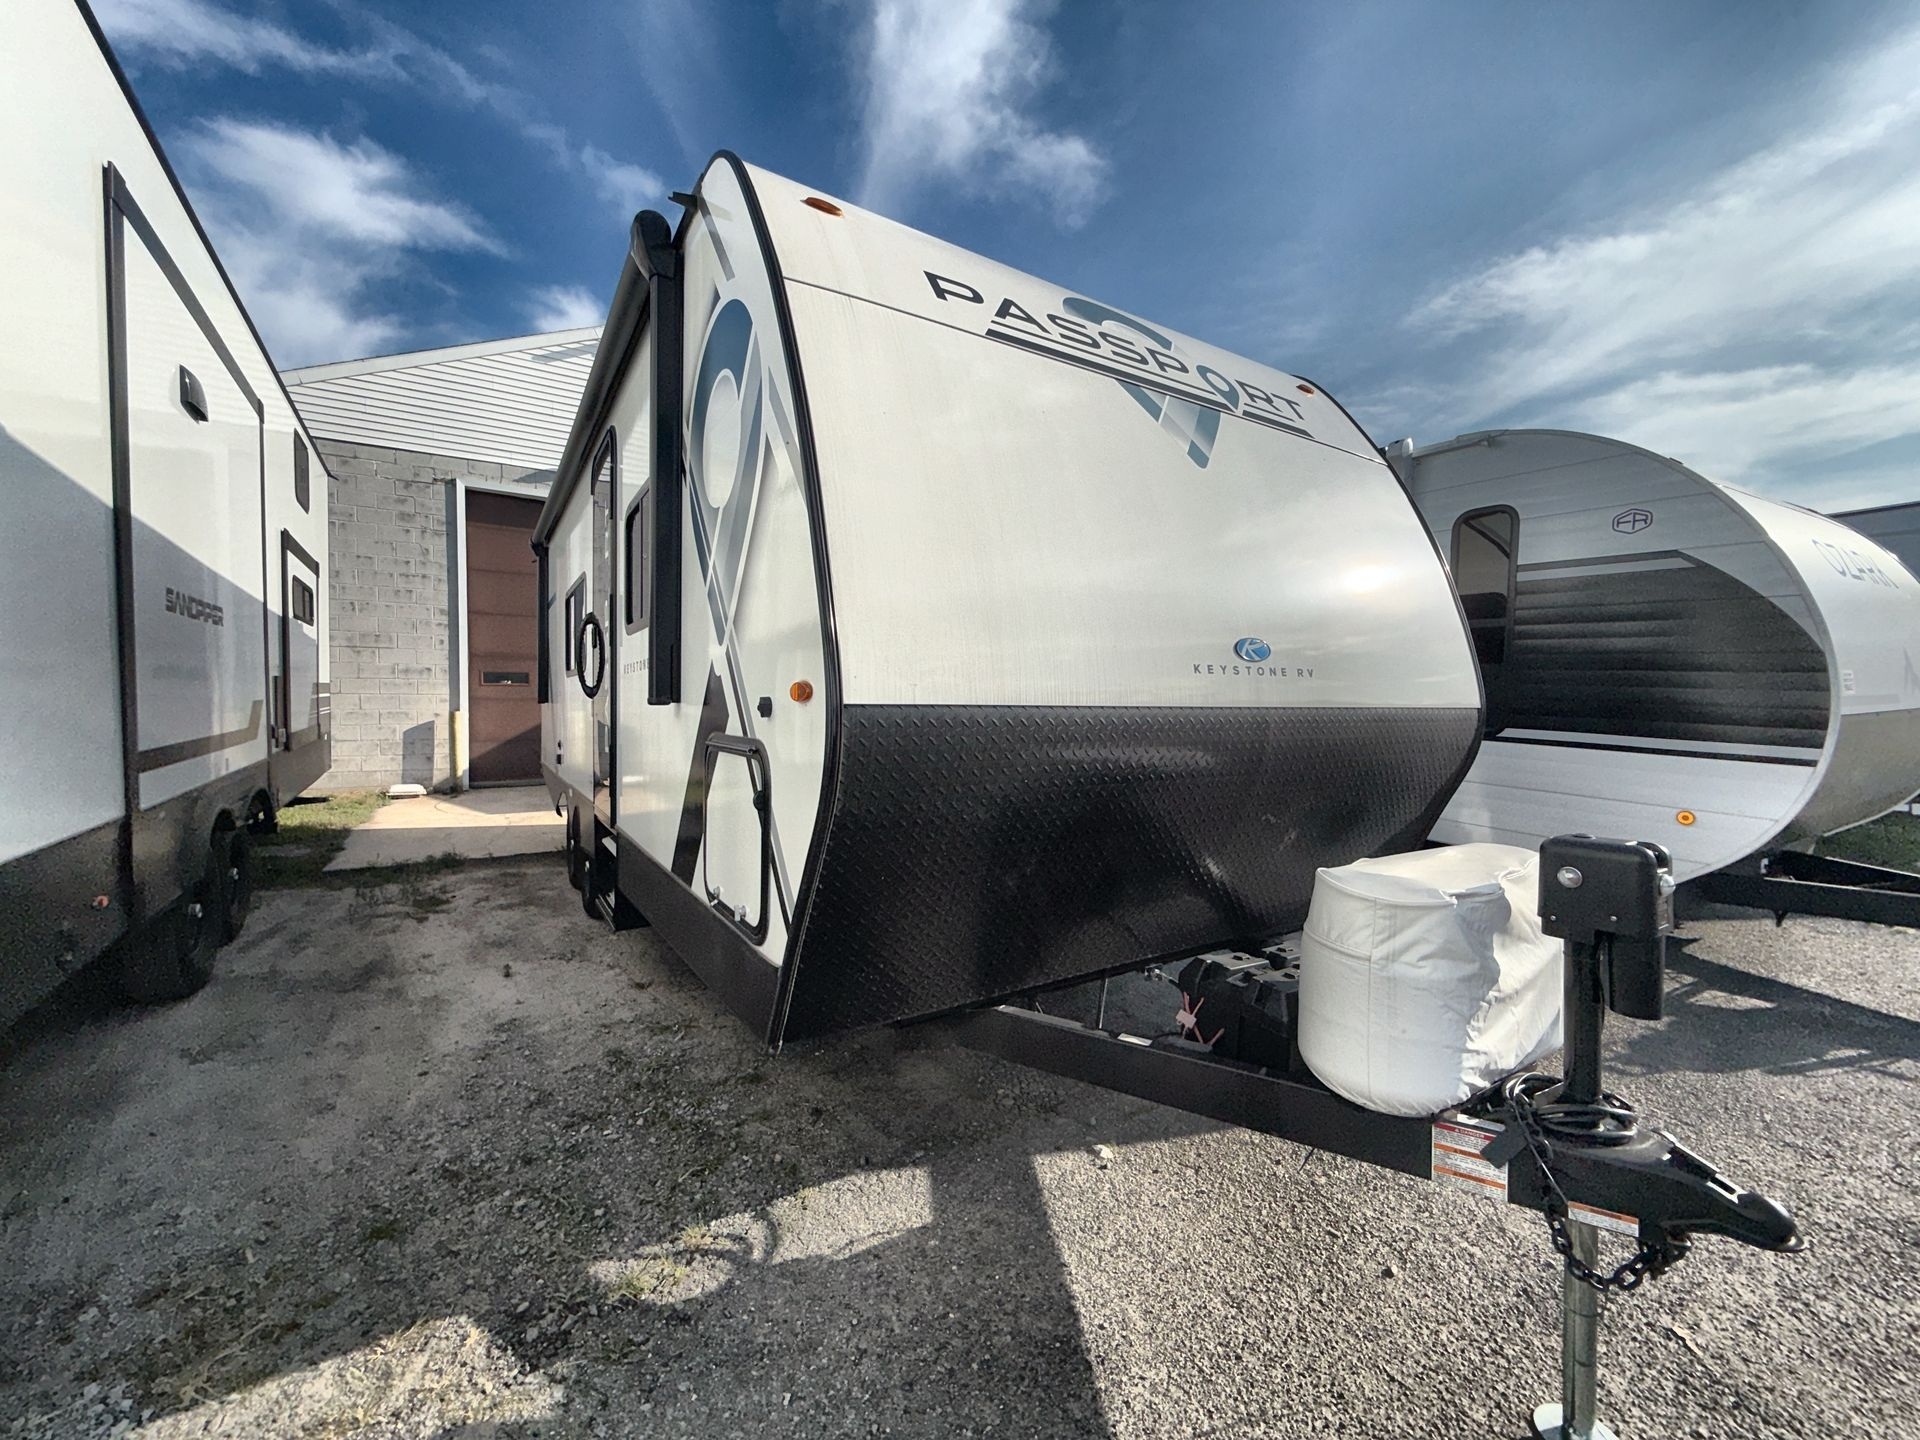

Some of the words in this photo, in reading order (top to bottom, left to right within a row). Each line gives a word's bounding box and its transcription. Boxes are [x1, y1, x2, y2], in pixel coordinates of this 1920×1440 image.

[923, 270, 1304, 420] PASSPORT
[1616, 512, 1649, 530] FR
[165, 587, 224, 627] SANDPIPER
[1193, 663, 1287, 677] KEYSTONE
[1297, 668, 1314, 678] RV
